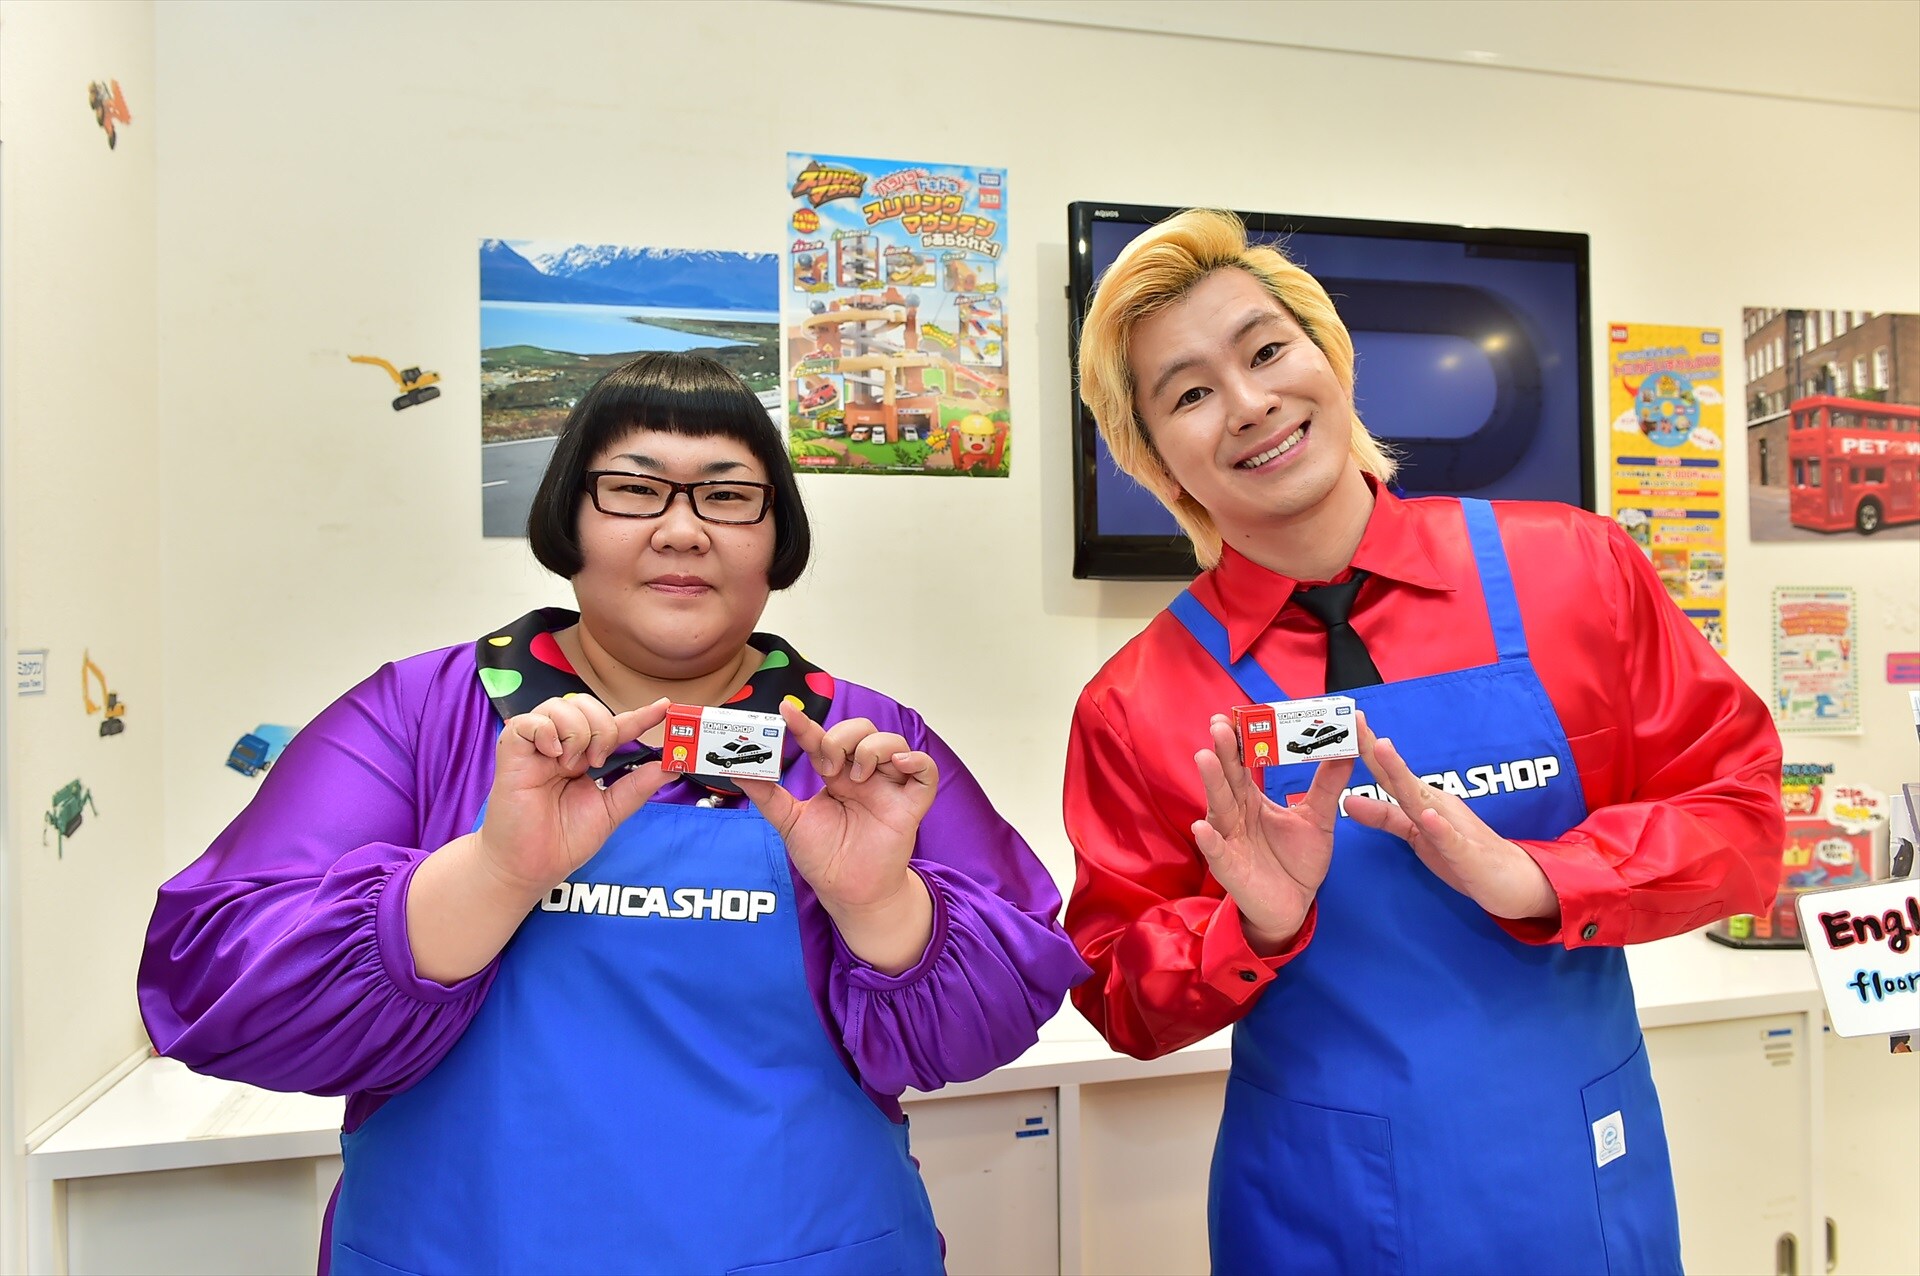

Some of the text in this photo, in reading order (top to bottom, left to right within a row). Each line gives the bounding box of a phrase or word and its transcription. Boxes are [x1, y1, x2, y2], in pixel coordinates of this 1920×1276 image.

[862, 194, 963, 225] スリリング
[901, 213, 996, 238] マウンテン
[1277, 708, 1328, 720] TOMICASHOP
[671, 725, 694, 738] トミカ
[702, 720, 755, 734] TOMICASHOP
[1249, 720, 1272, 733] トミカ
[540, 882, 776, 923] OMICASHOP
[1847, 969, 1920, 1003] floor
